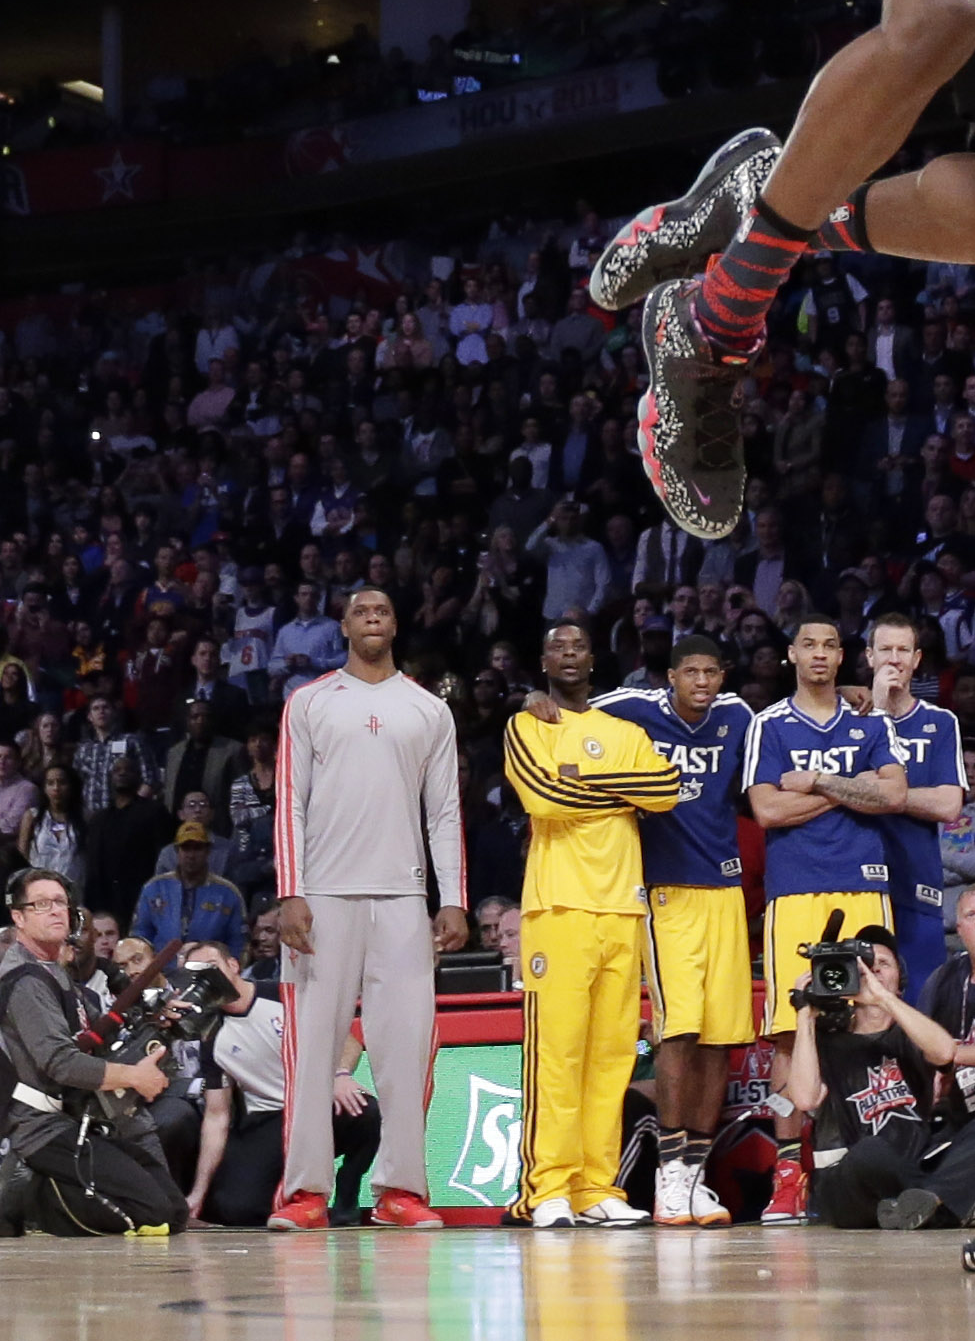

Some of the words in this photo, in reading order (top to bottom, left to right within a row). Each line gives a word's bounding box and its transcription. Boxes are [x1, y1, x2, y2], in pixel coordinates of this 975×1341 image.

[241, 645, 253, 666] 6
[653, 740, 724, 774] EAST
[790, 746, 860, 775] EAST
